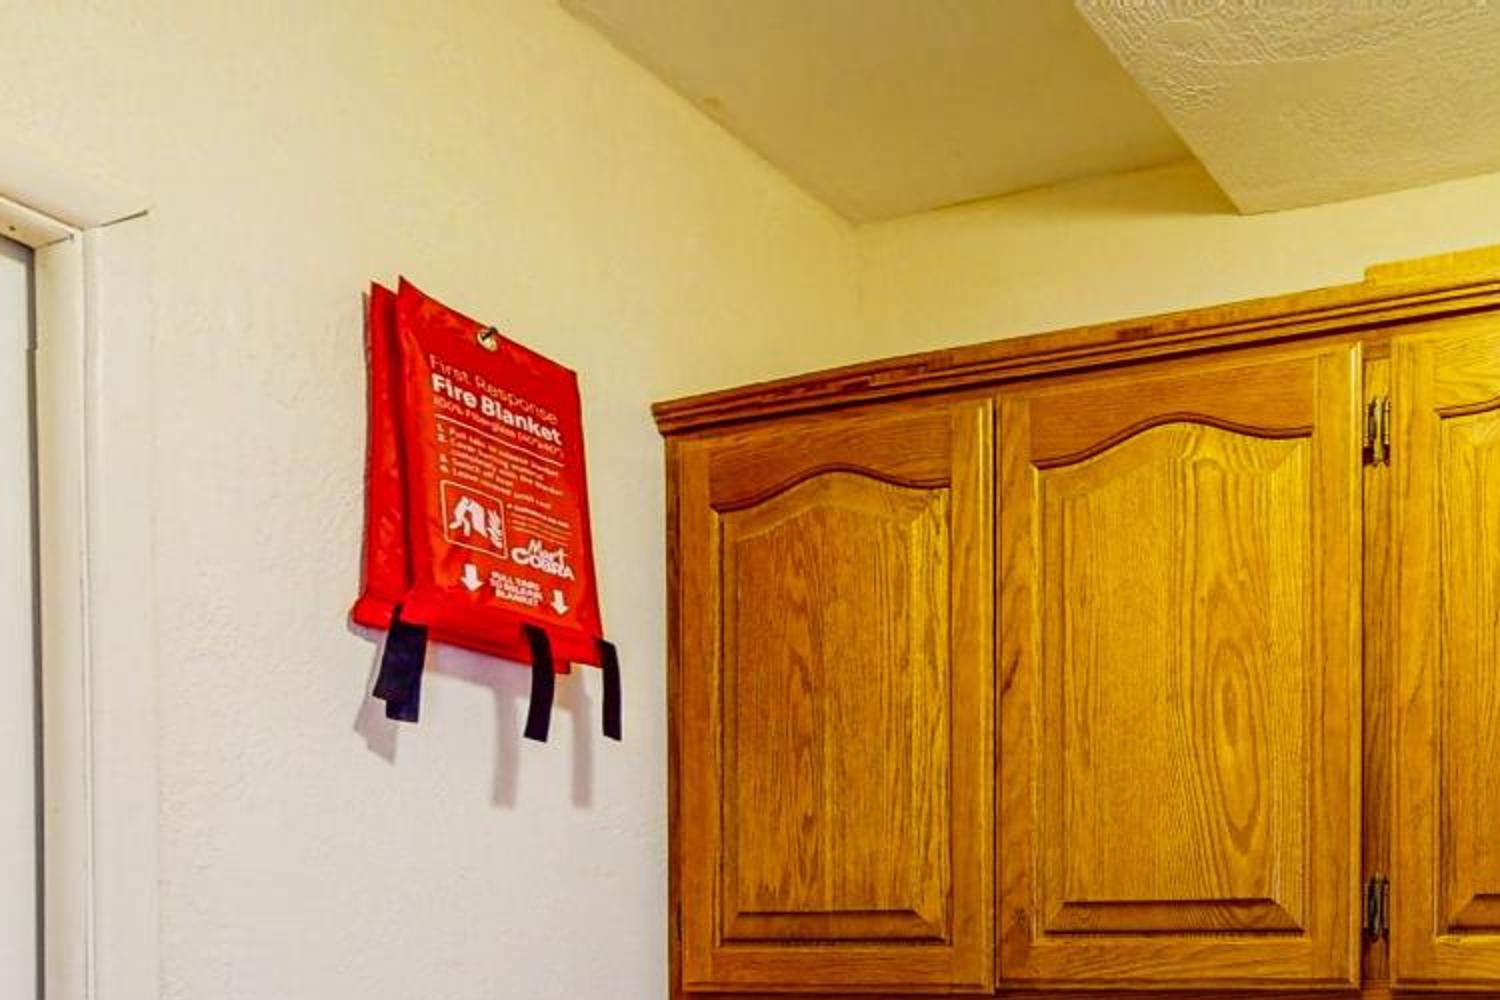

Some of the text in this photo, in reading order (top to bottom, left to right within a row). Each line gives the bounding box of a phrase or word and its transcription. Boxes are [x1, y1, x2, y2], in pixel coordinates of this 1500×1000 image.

[431, 372, 563, 446] Fire Blanket
[474, 374, 559, 425] Response
